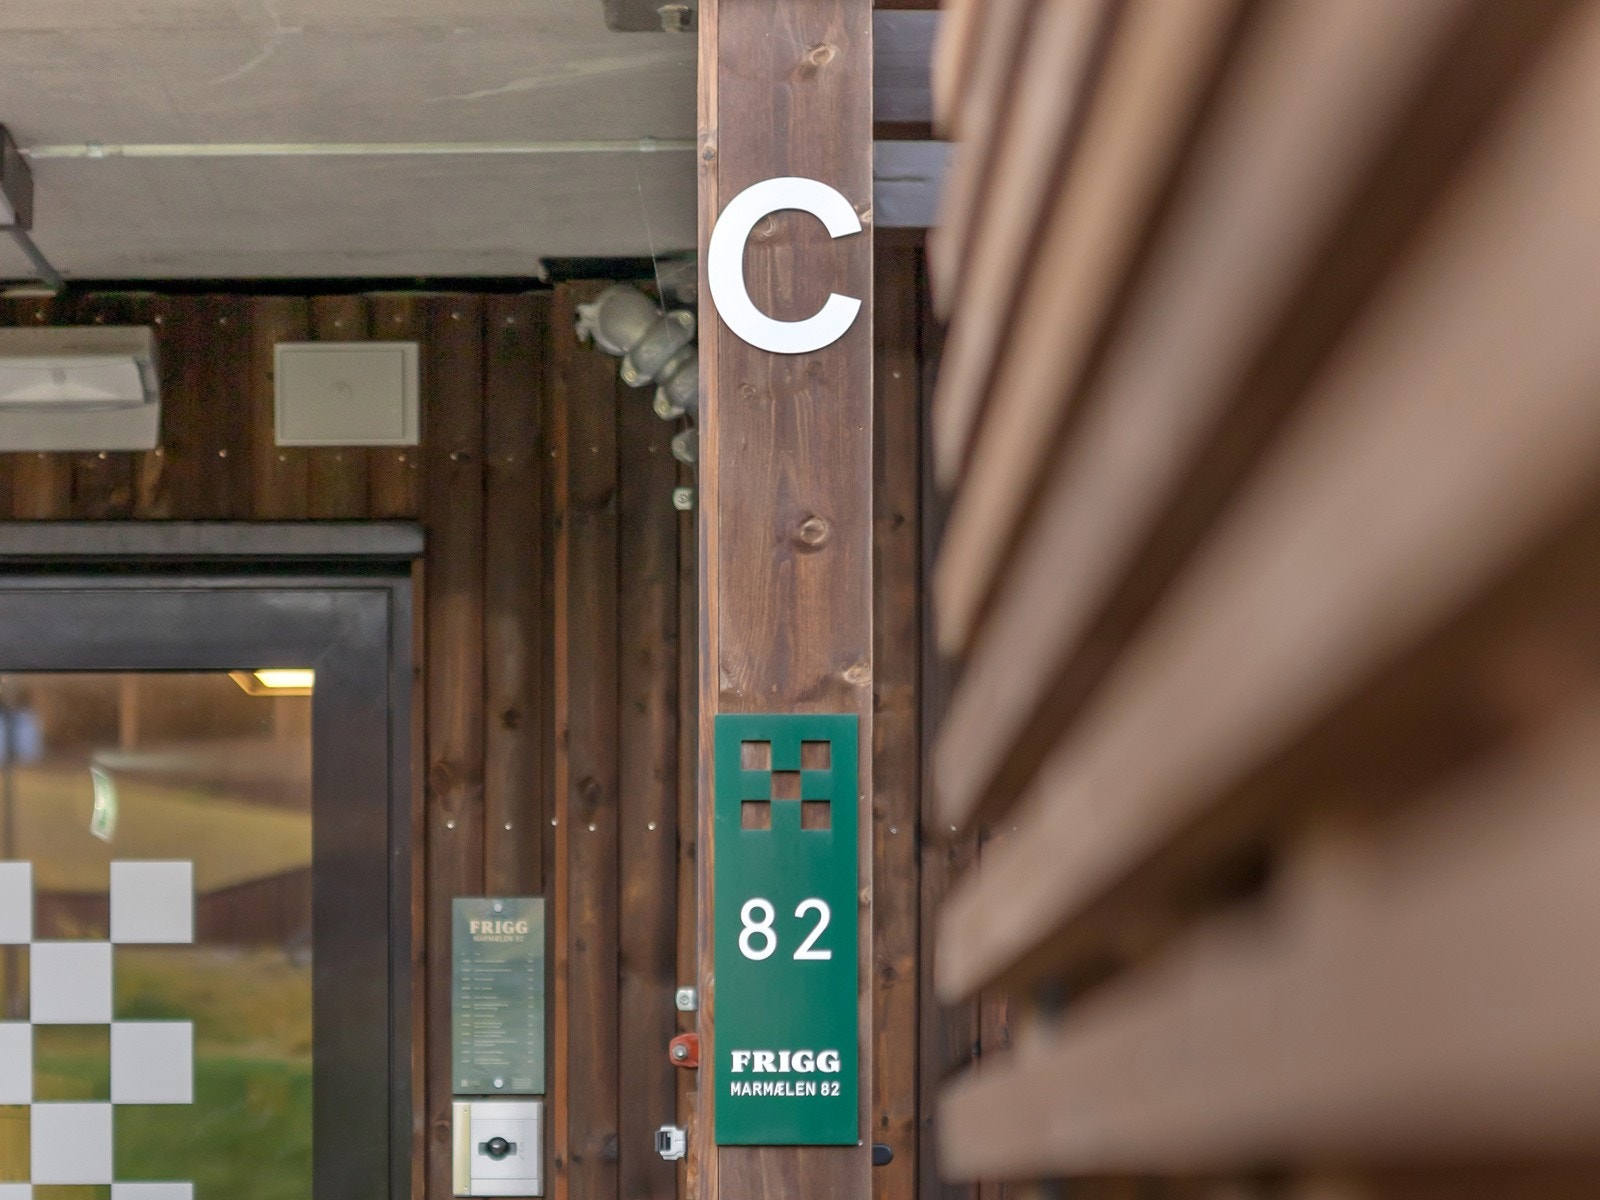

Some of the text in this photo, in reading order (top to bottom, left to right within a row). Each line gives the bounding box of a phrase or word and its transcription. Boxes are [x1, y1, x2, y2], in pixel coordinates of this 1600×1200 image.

[708, 177, 862, 354] C
[470, 921, 528, 934] FRIGG
[739, 898, 832, 960] 82
[731, 1050, 840, 1073] FRIGG
[730, 1081, 840, 1097] MARMÆLEN 82
